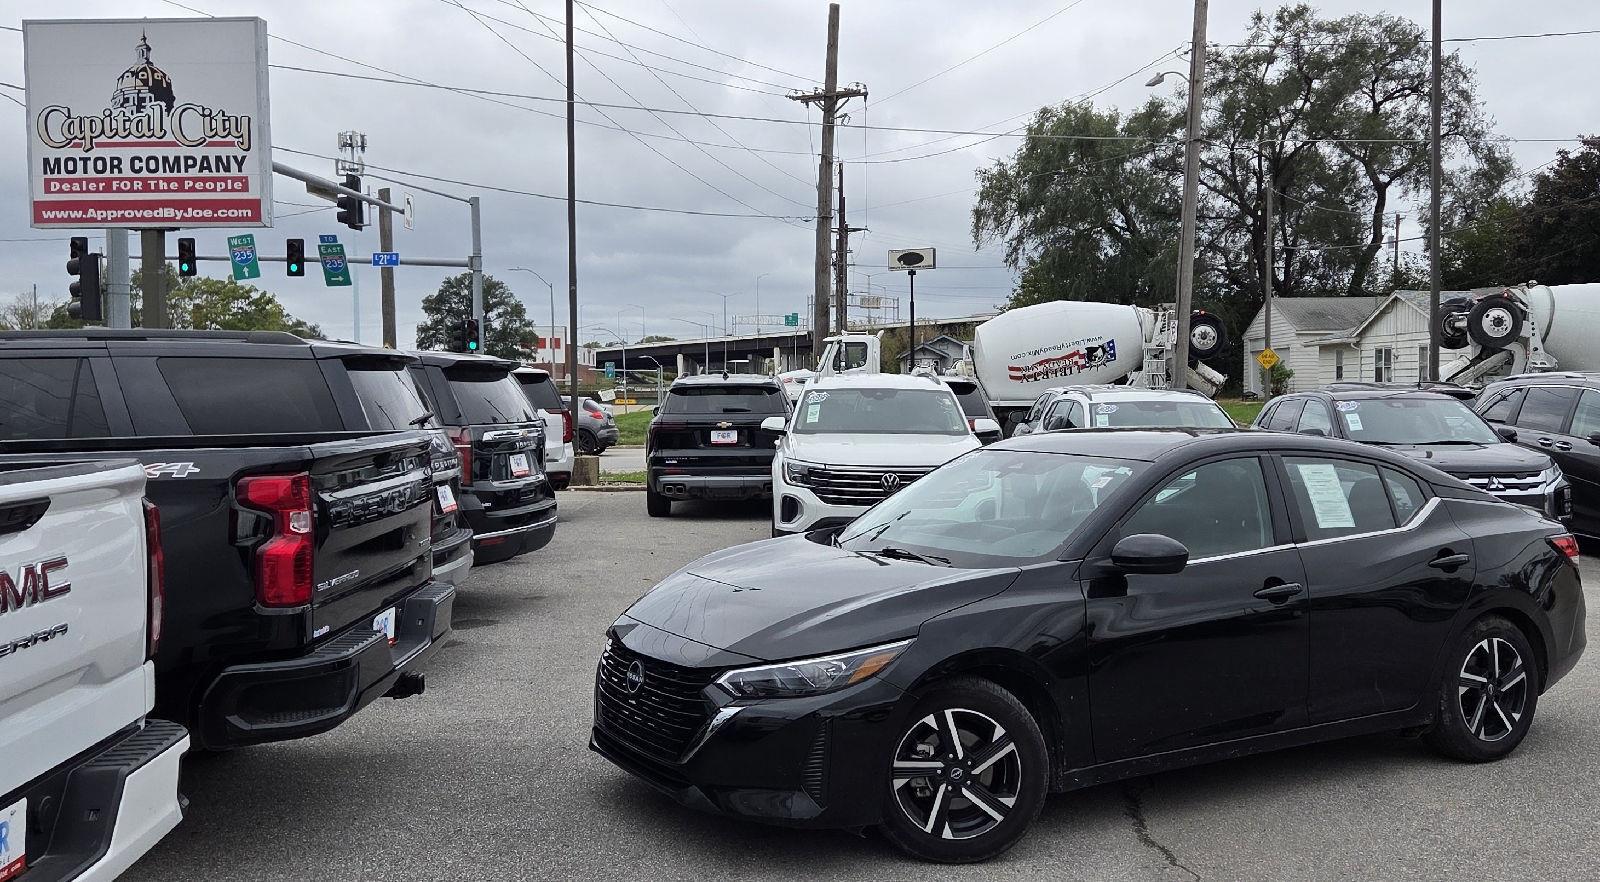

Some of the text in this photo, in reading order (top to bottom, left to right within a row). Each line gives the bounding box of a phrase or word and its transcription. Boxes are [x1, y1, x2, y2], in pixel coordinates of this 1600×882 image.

[37, 101, 251, 153] Capital City
[42, 154, 248, 176] MOTOR COMPANY
[50, 180, 244, 192] Dealer FOR The People
[42, 207, 252, 220] www.ApprovedByJoe.com
[230, 236, 252, 246] WEST
[234, 250, 253, 261] 235
[320, 245, 341, 254] EAST
[325, 259, 344, 268] 235
[1019, 364, 1082, 384] LIBERTY
[0, 555, 72, 616] MC
